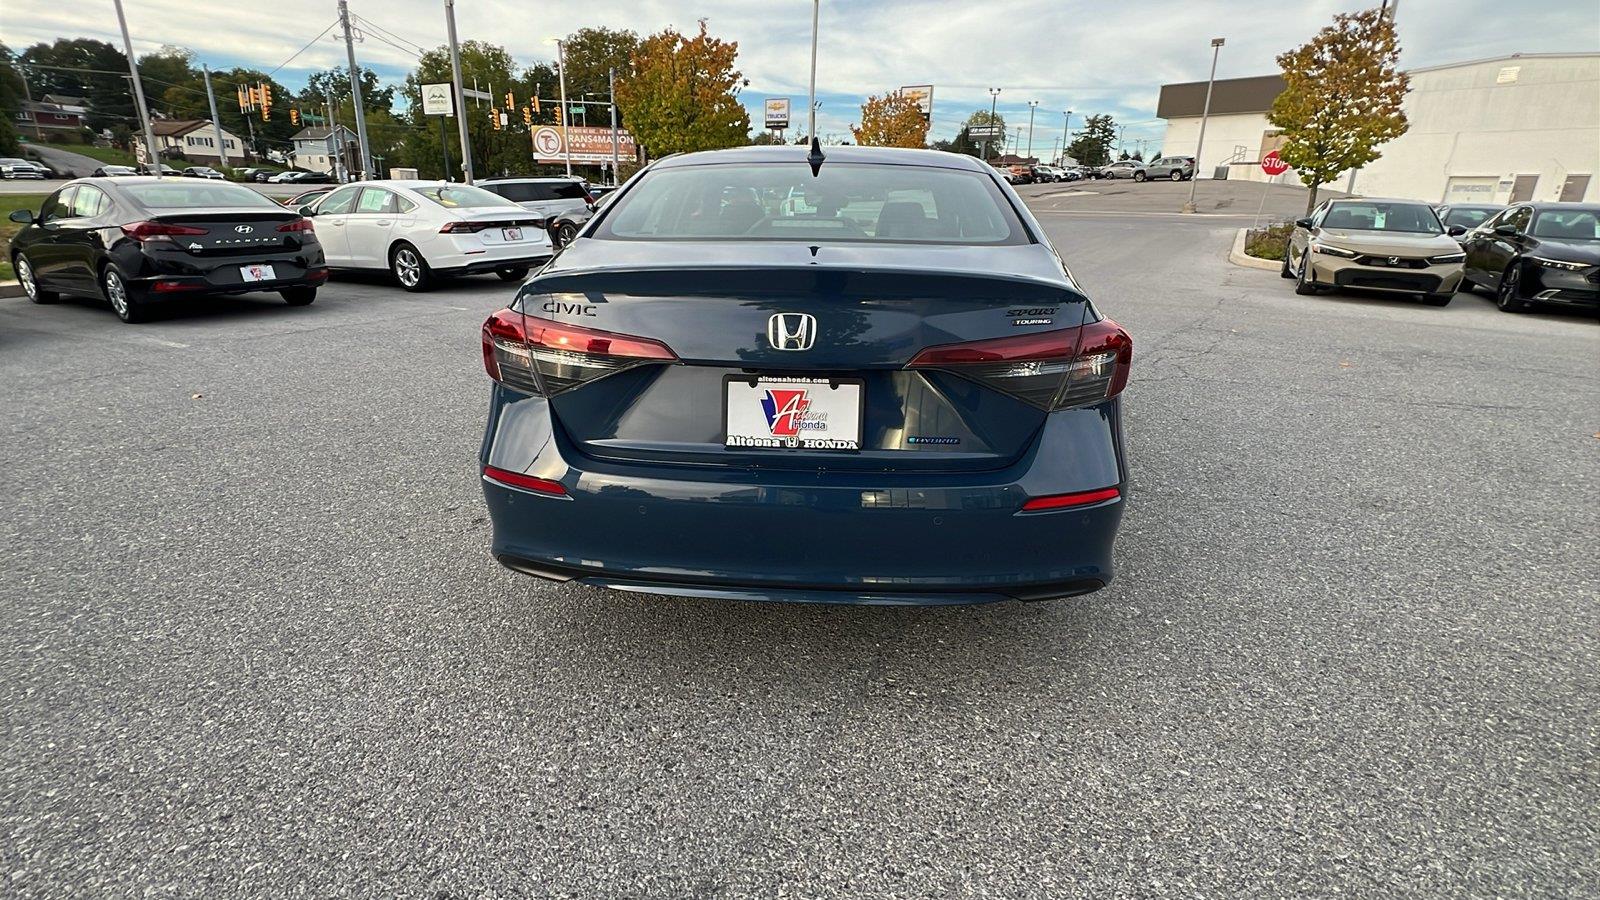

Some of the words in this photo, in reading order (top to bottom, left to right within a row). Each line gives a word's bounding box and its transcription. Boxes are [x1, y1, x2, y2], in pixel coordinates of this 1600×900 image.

[563, 134, 634, 144] RANS4MAION
[542, 302, 597, 317] CIVIC
[1005, 307, 1060, 317] SPORT
[757, 376, 830, 384] altoonahonda.com
[793, 420, 826, 430] Honda
[726, 435, 781, 448] Altoona
[803, 438, 859, 450] HONDA
